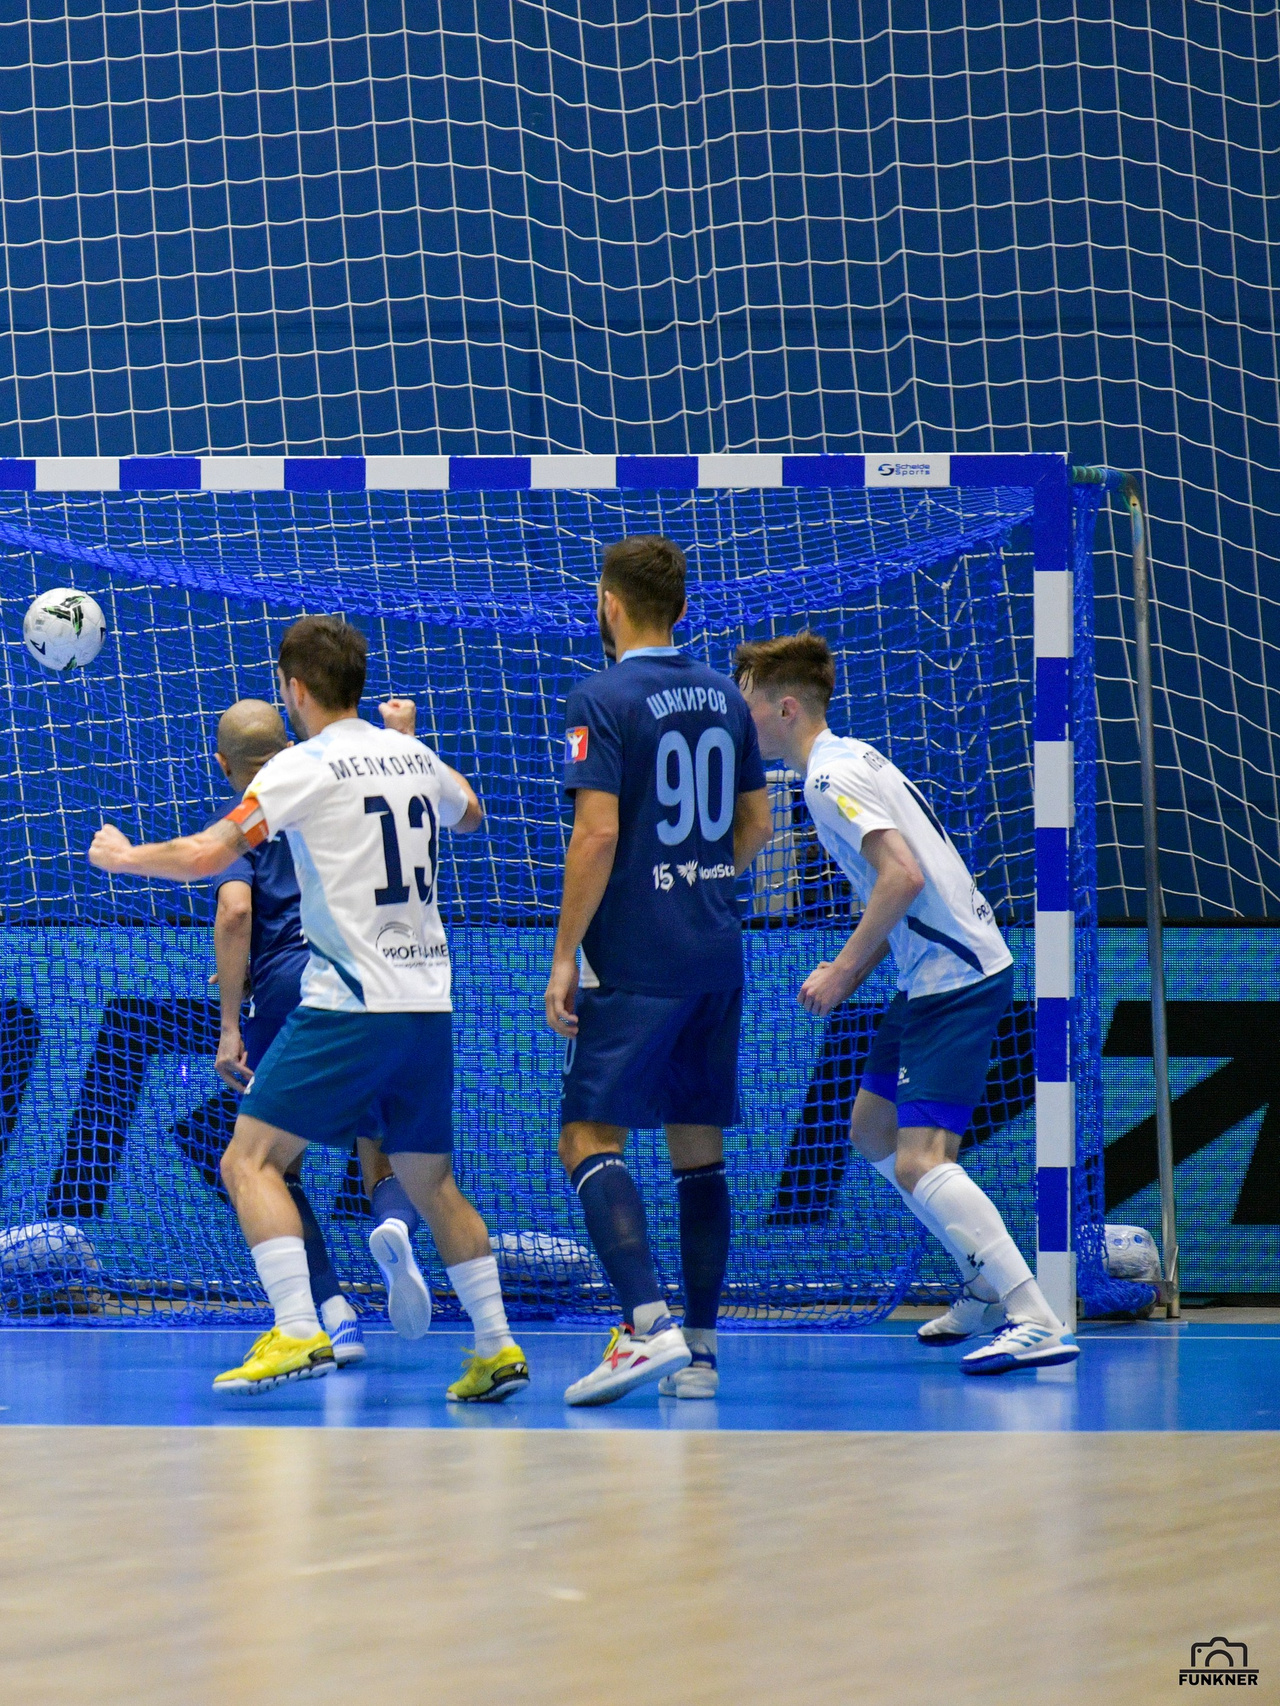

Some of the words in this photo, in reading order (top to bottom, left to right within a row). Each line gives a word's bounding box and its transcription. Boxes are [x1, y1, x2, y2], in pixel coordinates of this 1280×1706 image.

[646, 687, 727, 720] ШАКИРОВ
[656, 727, 736, 846] 90
[363, 793, 438, 907] 13
[652, 862, 675, 893] 15
